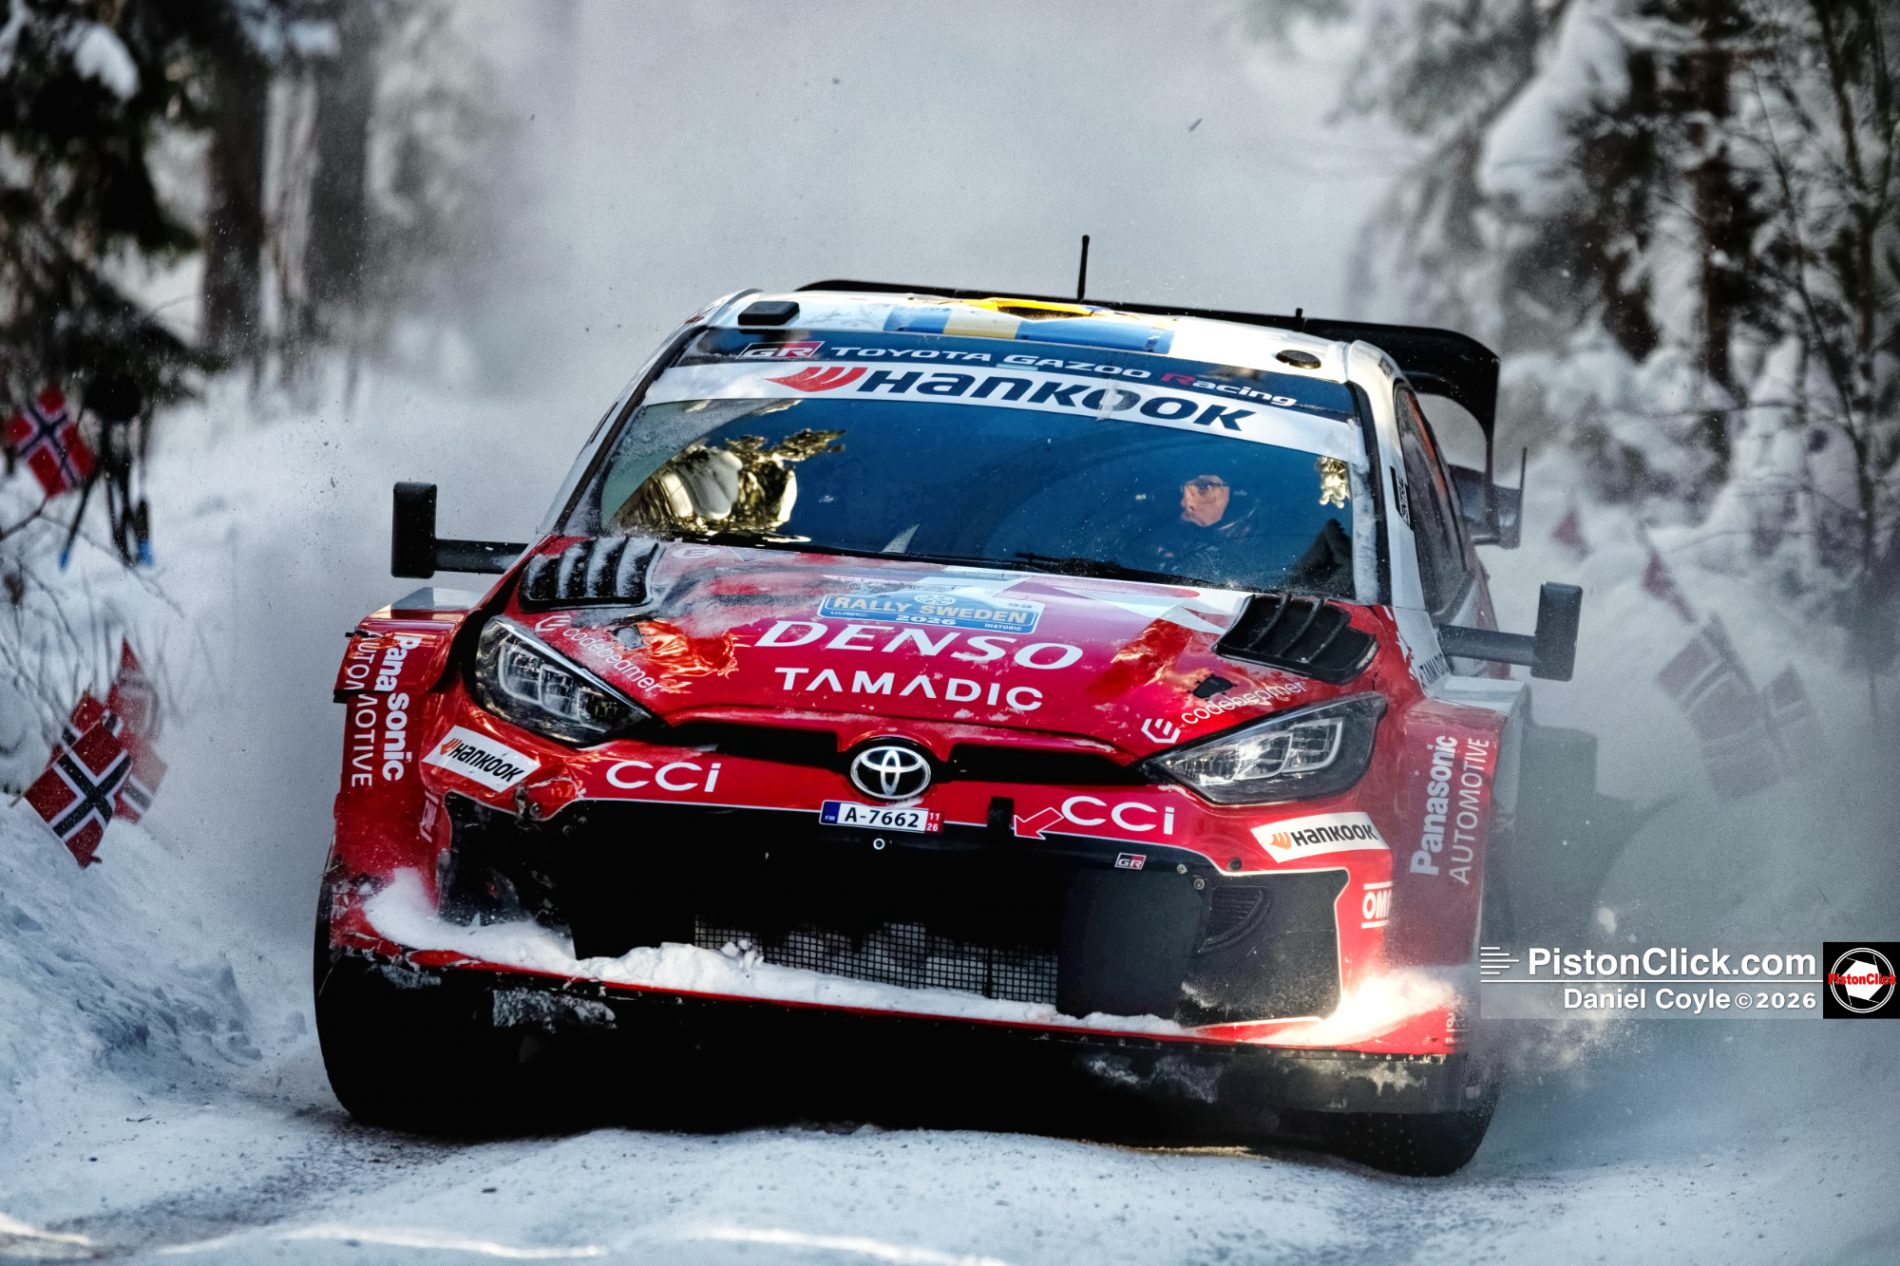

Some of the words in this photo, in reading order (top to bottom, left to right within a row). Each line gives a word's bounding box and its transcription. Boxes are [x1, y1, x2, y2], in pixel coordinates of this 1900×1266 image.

[743, 345, 814, 359] GR
[830, 346, 994, 363] TOYOTA
[1002, 354, 1153, 380] GAZOO
[1160, 372, 1298, 408] Racing
[832, 596, 913, 614] RALLY
[919, 604, 1028, 625] SWEDEN
[895, 614, 957, 627] 2026
[984, 622, 1022, 632] HISTORIC
[562, 628, 663, 693] codebeamer
[752, 620, 1084, 671] DENSO
[374, 633, 423, 782] Panasonic
[774, 666, 1044, 712] TAMADIC
[1181, 680, 1307, 725] codebeamer
[844, 806, 920, 829] A-7662
[1409, 735, 1459, 876] Panasonic
[1449, 737, 1490, 886] AUTOMOTIVE
[926, 822, 939, 832] 26
[1117, 857, 1144, 869] GR
[1362, 888, 1393, 920] OM
